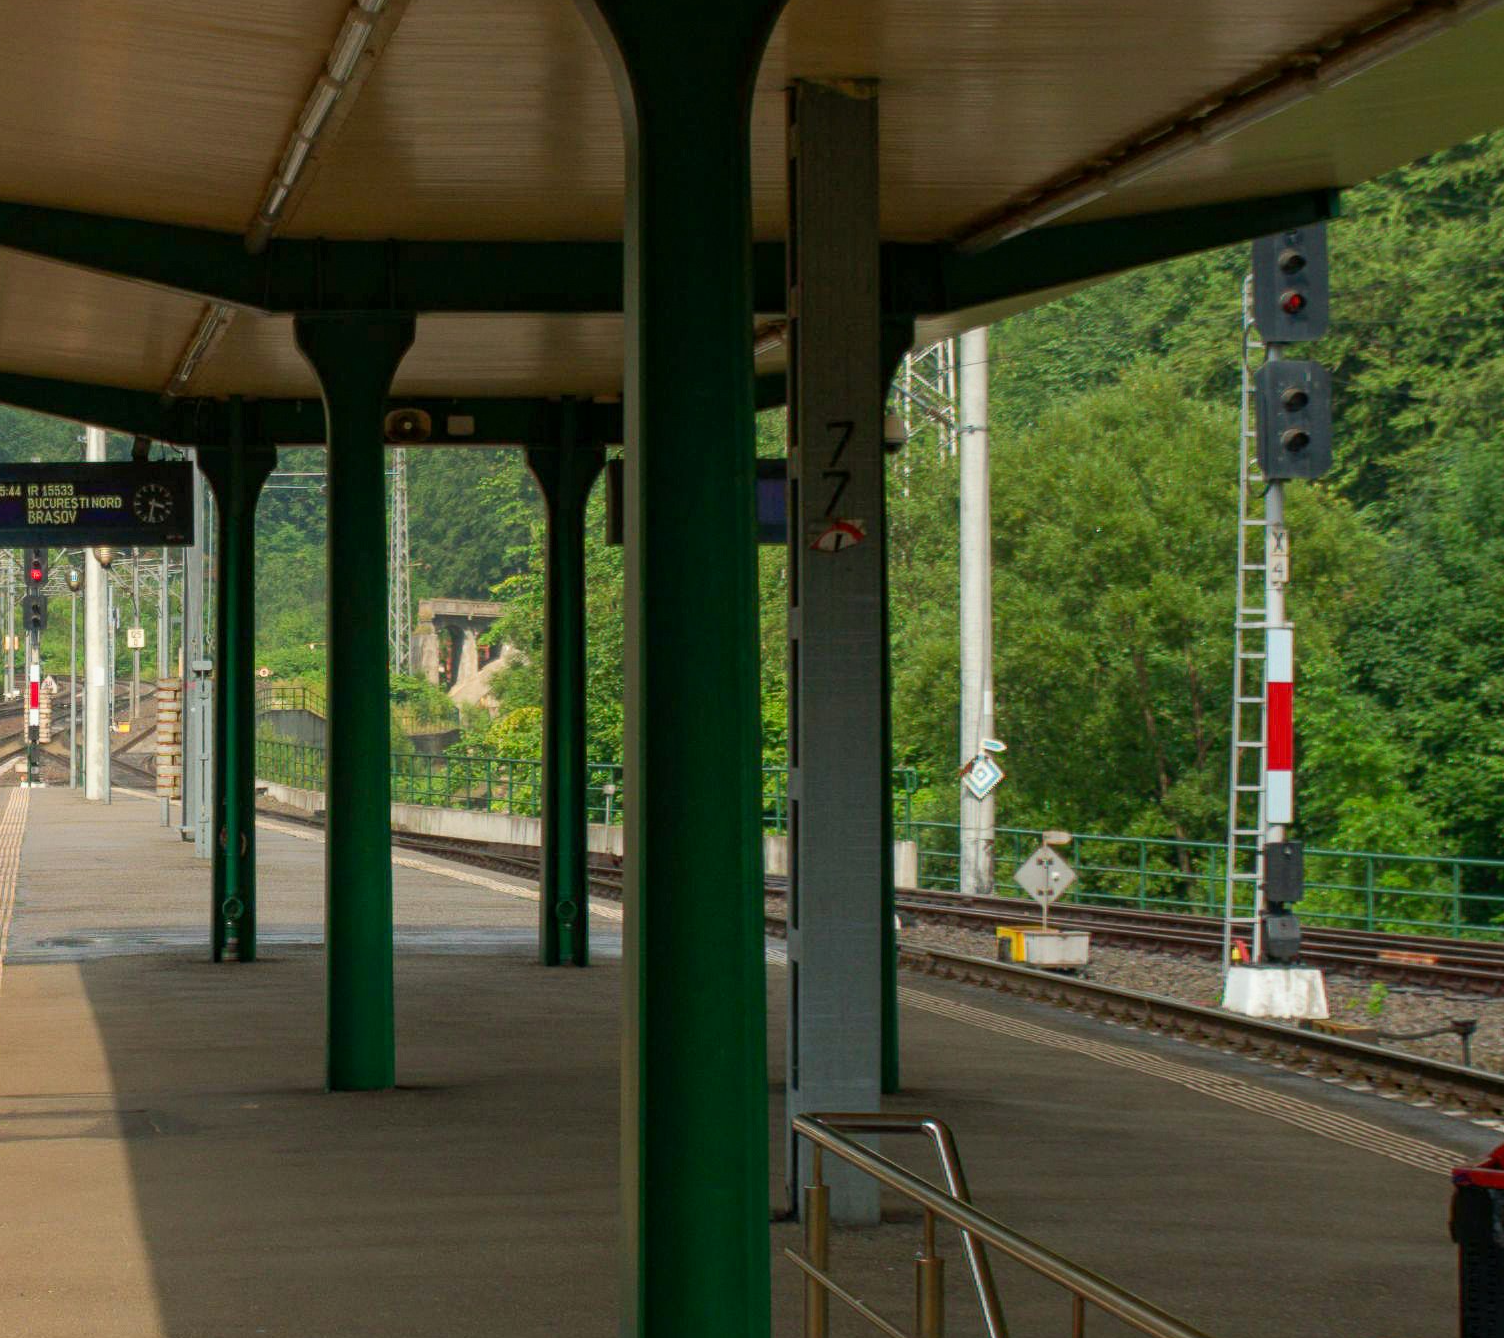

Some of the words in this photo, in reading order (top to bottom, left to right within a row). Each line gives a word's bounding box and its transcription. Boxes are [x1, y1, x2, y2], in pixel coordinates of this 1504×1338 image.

[27, 484, 39, 497] IR
[42, 484, 74, 496] 15533
[27, 497, 90, 509] BUCURESTI
[91, 497, 122, 509] NORD
